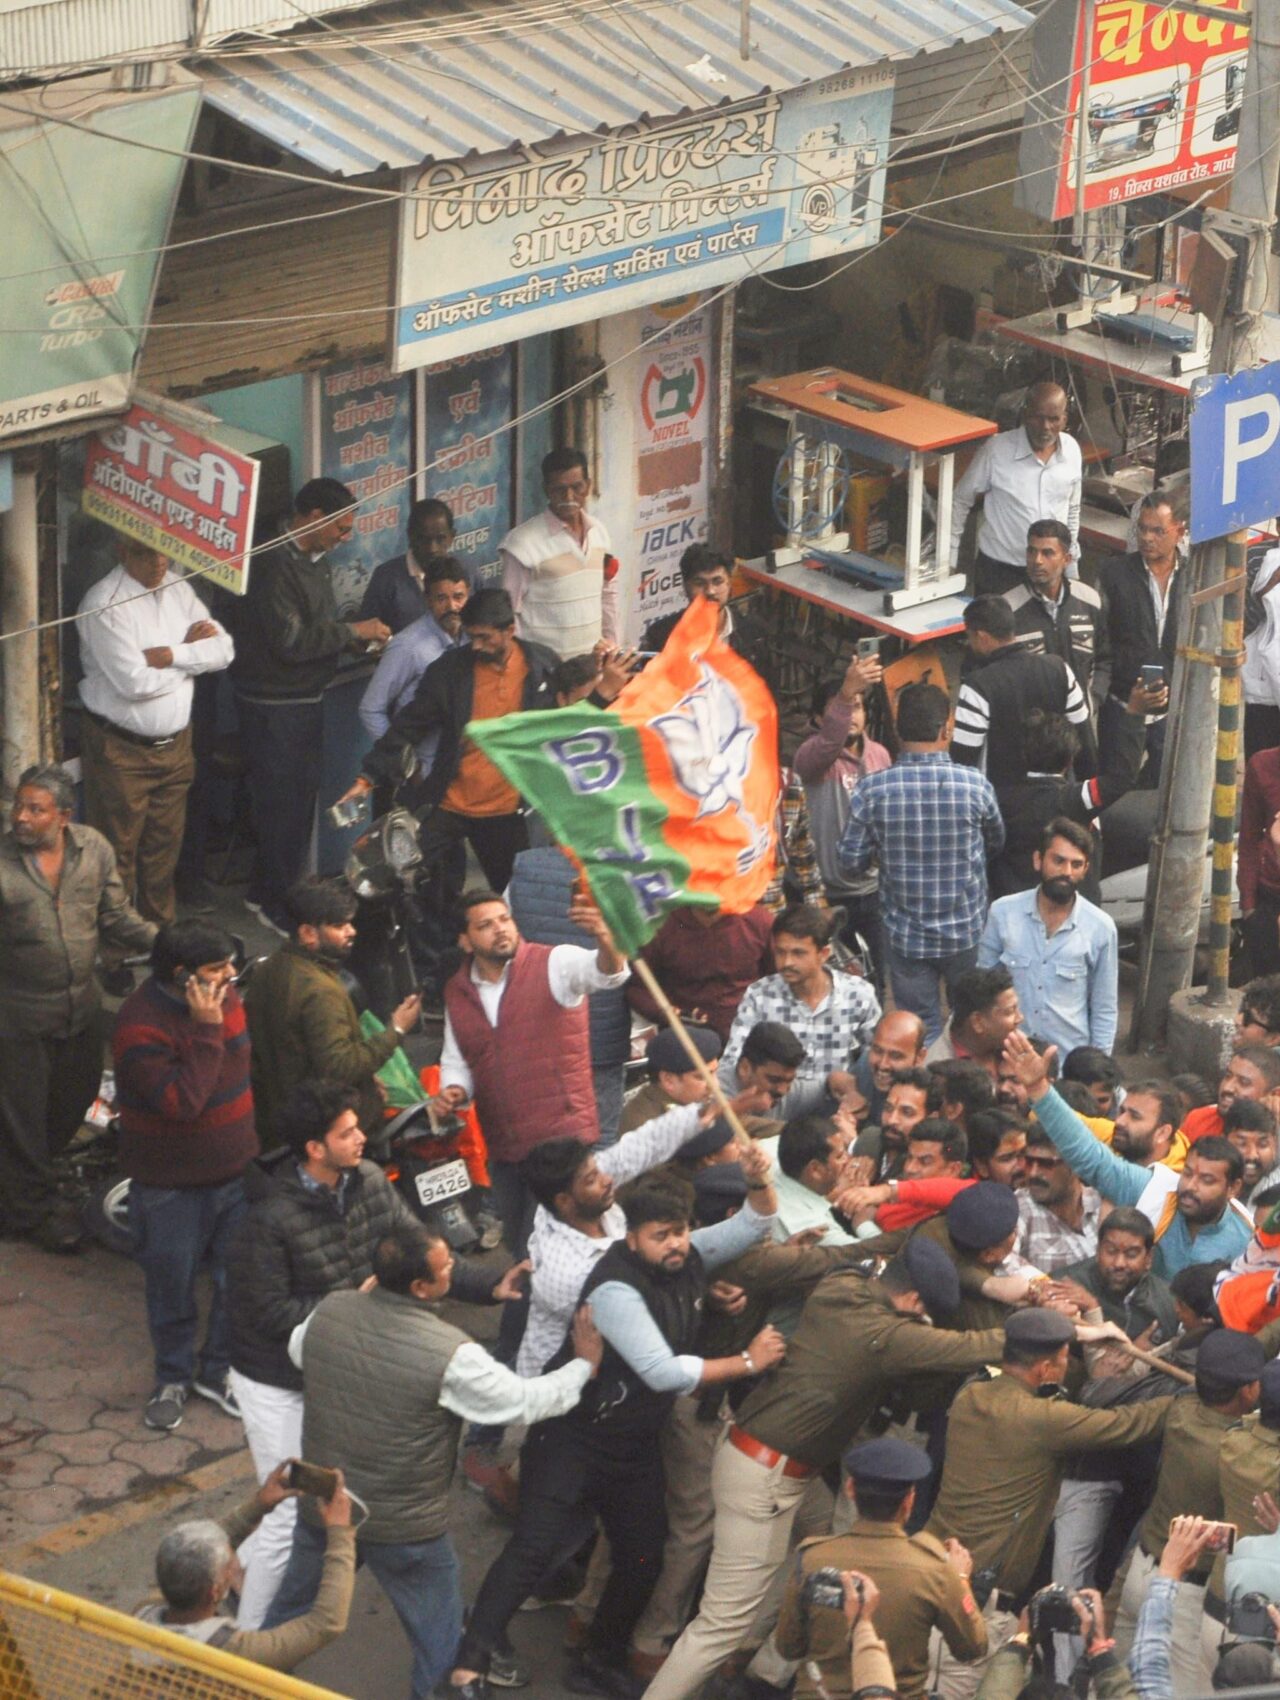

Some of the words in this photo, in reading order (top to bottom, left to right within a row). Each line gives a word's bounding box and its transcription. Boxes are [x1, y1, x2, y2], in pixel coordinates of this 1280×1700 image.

[1153, 165, 1188, 189] यशवंत
[1212, 151, 1238, 174] गांध
[497, 275, 557, 309] मशीन
[673, 233, 704, 264] एवं
[56, 399, 68, 414] &
[74, 391, 103, 410] OIL
